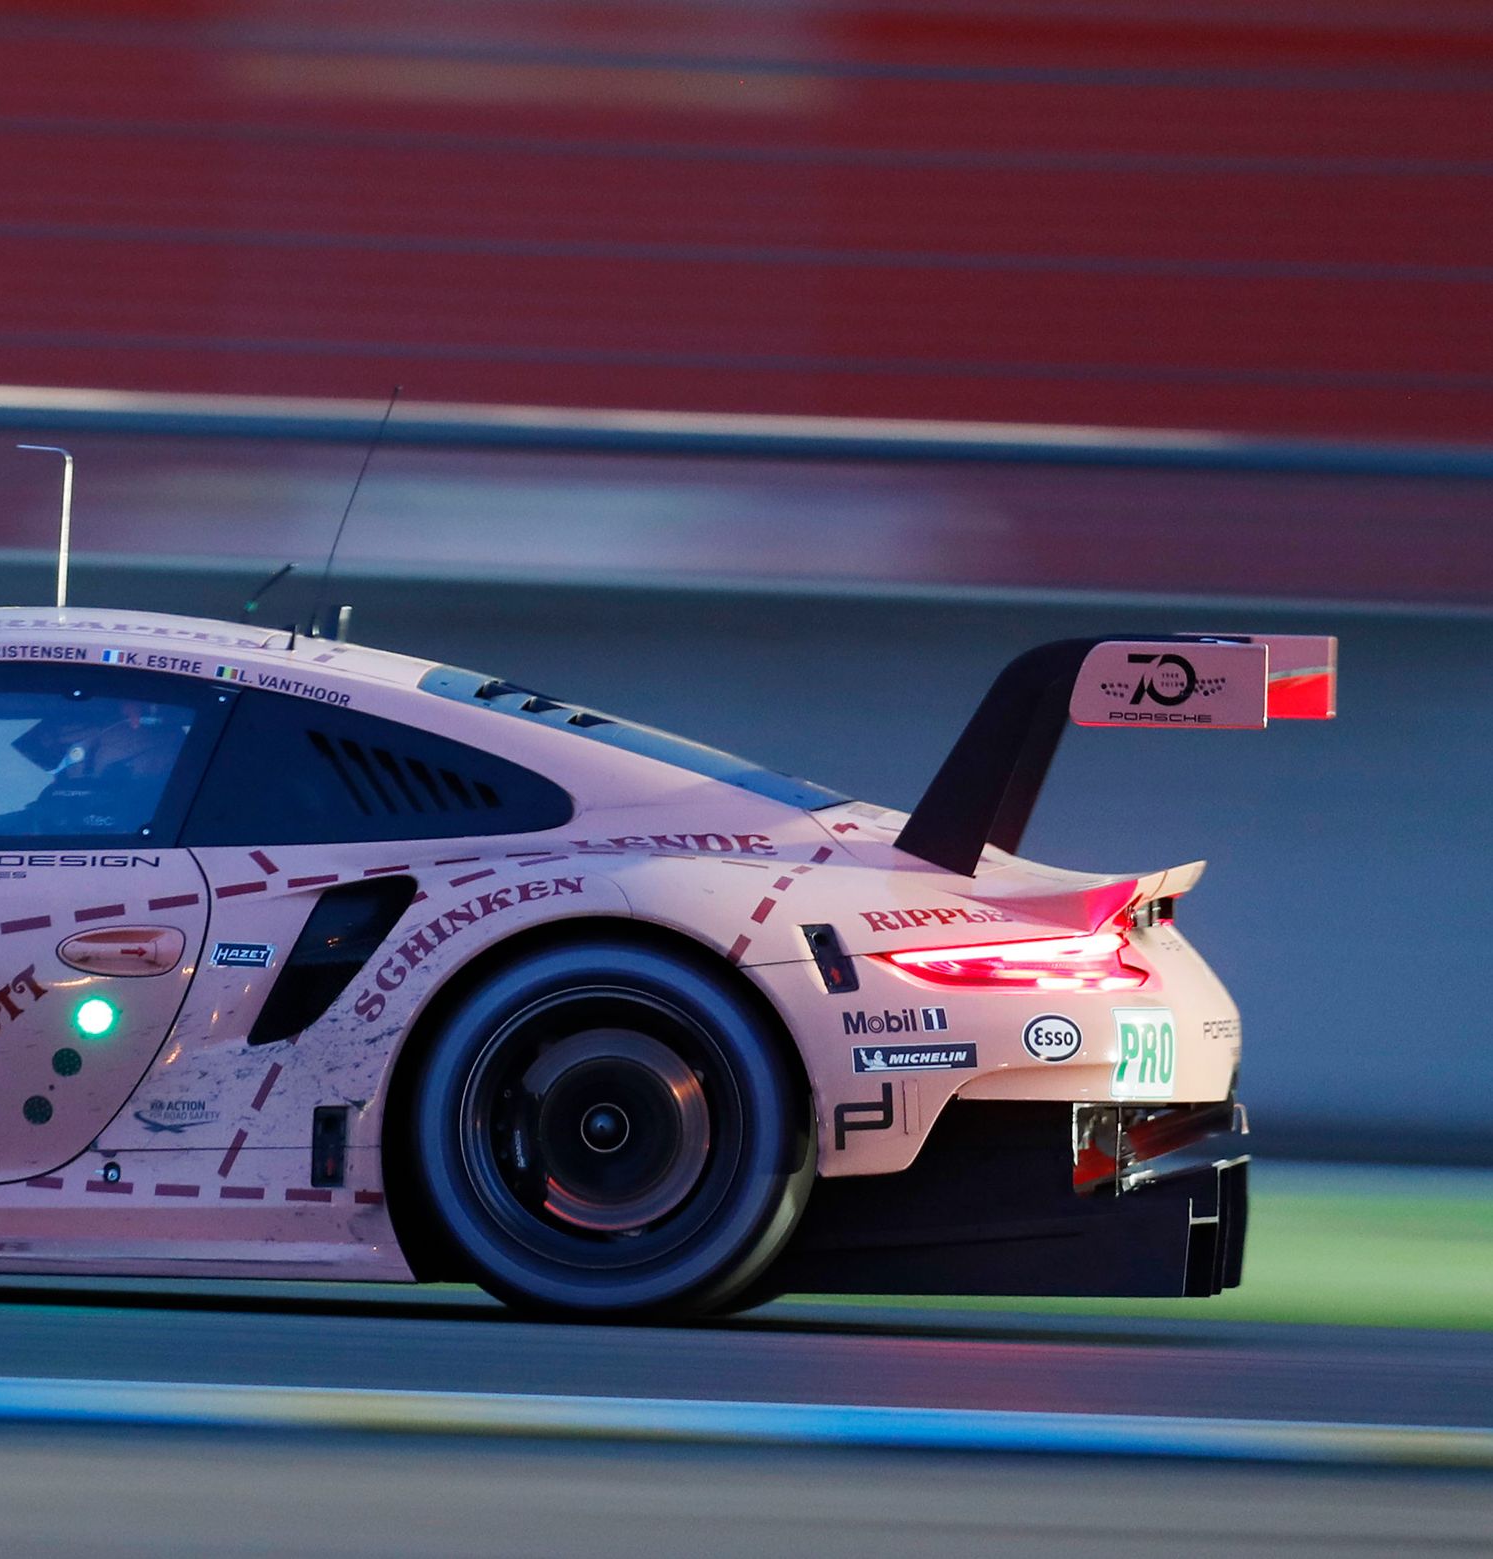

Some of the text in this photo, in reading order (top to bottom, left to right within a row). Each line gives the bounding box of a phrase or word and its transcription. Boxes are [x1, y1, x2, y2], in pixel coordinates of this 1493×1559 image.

[126, 653, 203, 674] K. ESTRE
[238, 670, 351, 707] L. VANTHOOR
[1128, 654, 1196, 706] 70
[1109, 712, 1212, 723] PORSCHE
[569, 833, 778, 855] LENDE
[217, 948, 267, 960] HAZET
[355, 876, 586, 1023] SCHINKEN
[842, 1009, 917, 1035] Mobil
[888, 1051, 967, 1065] MICHELIN
[1116, 1022, 1173, 1084] PRO
[166, 1100, 206, 1111] ACTION
